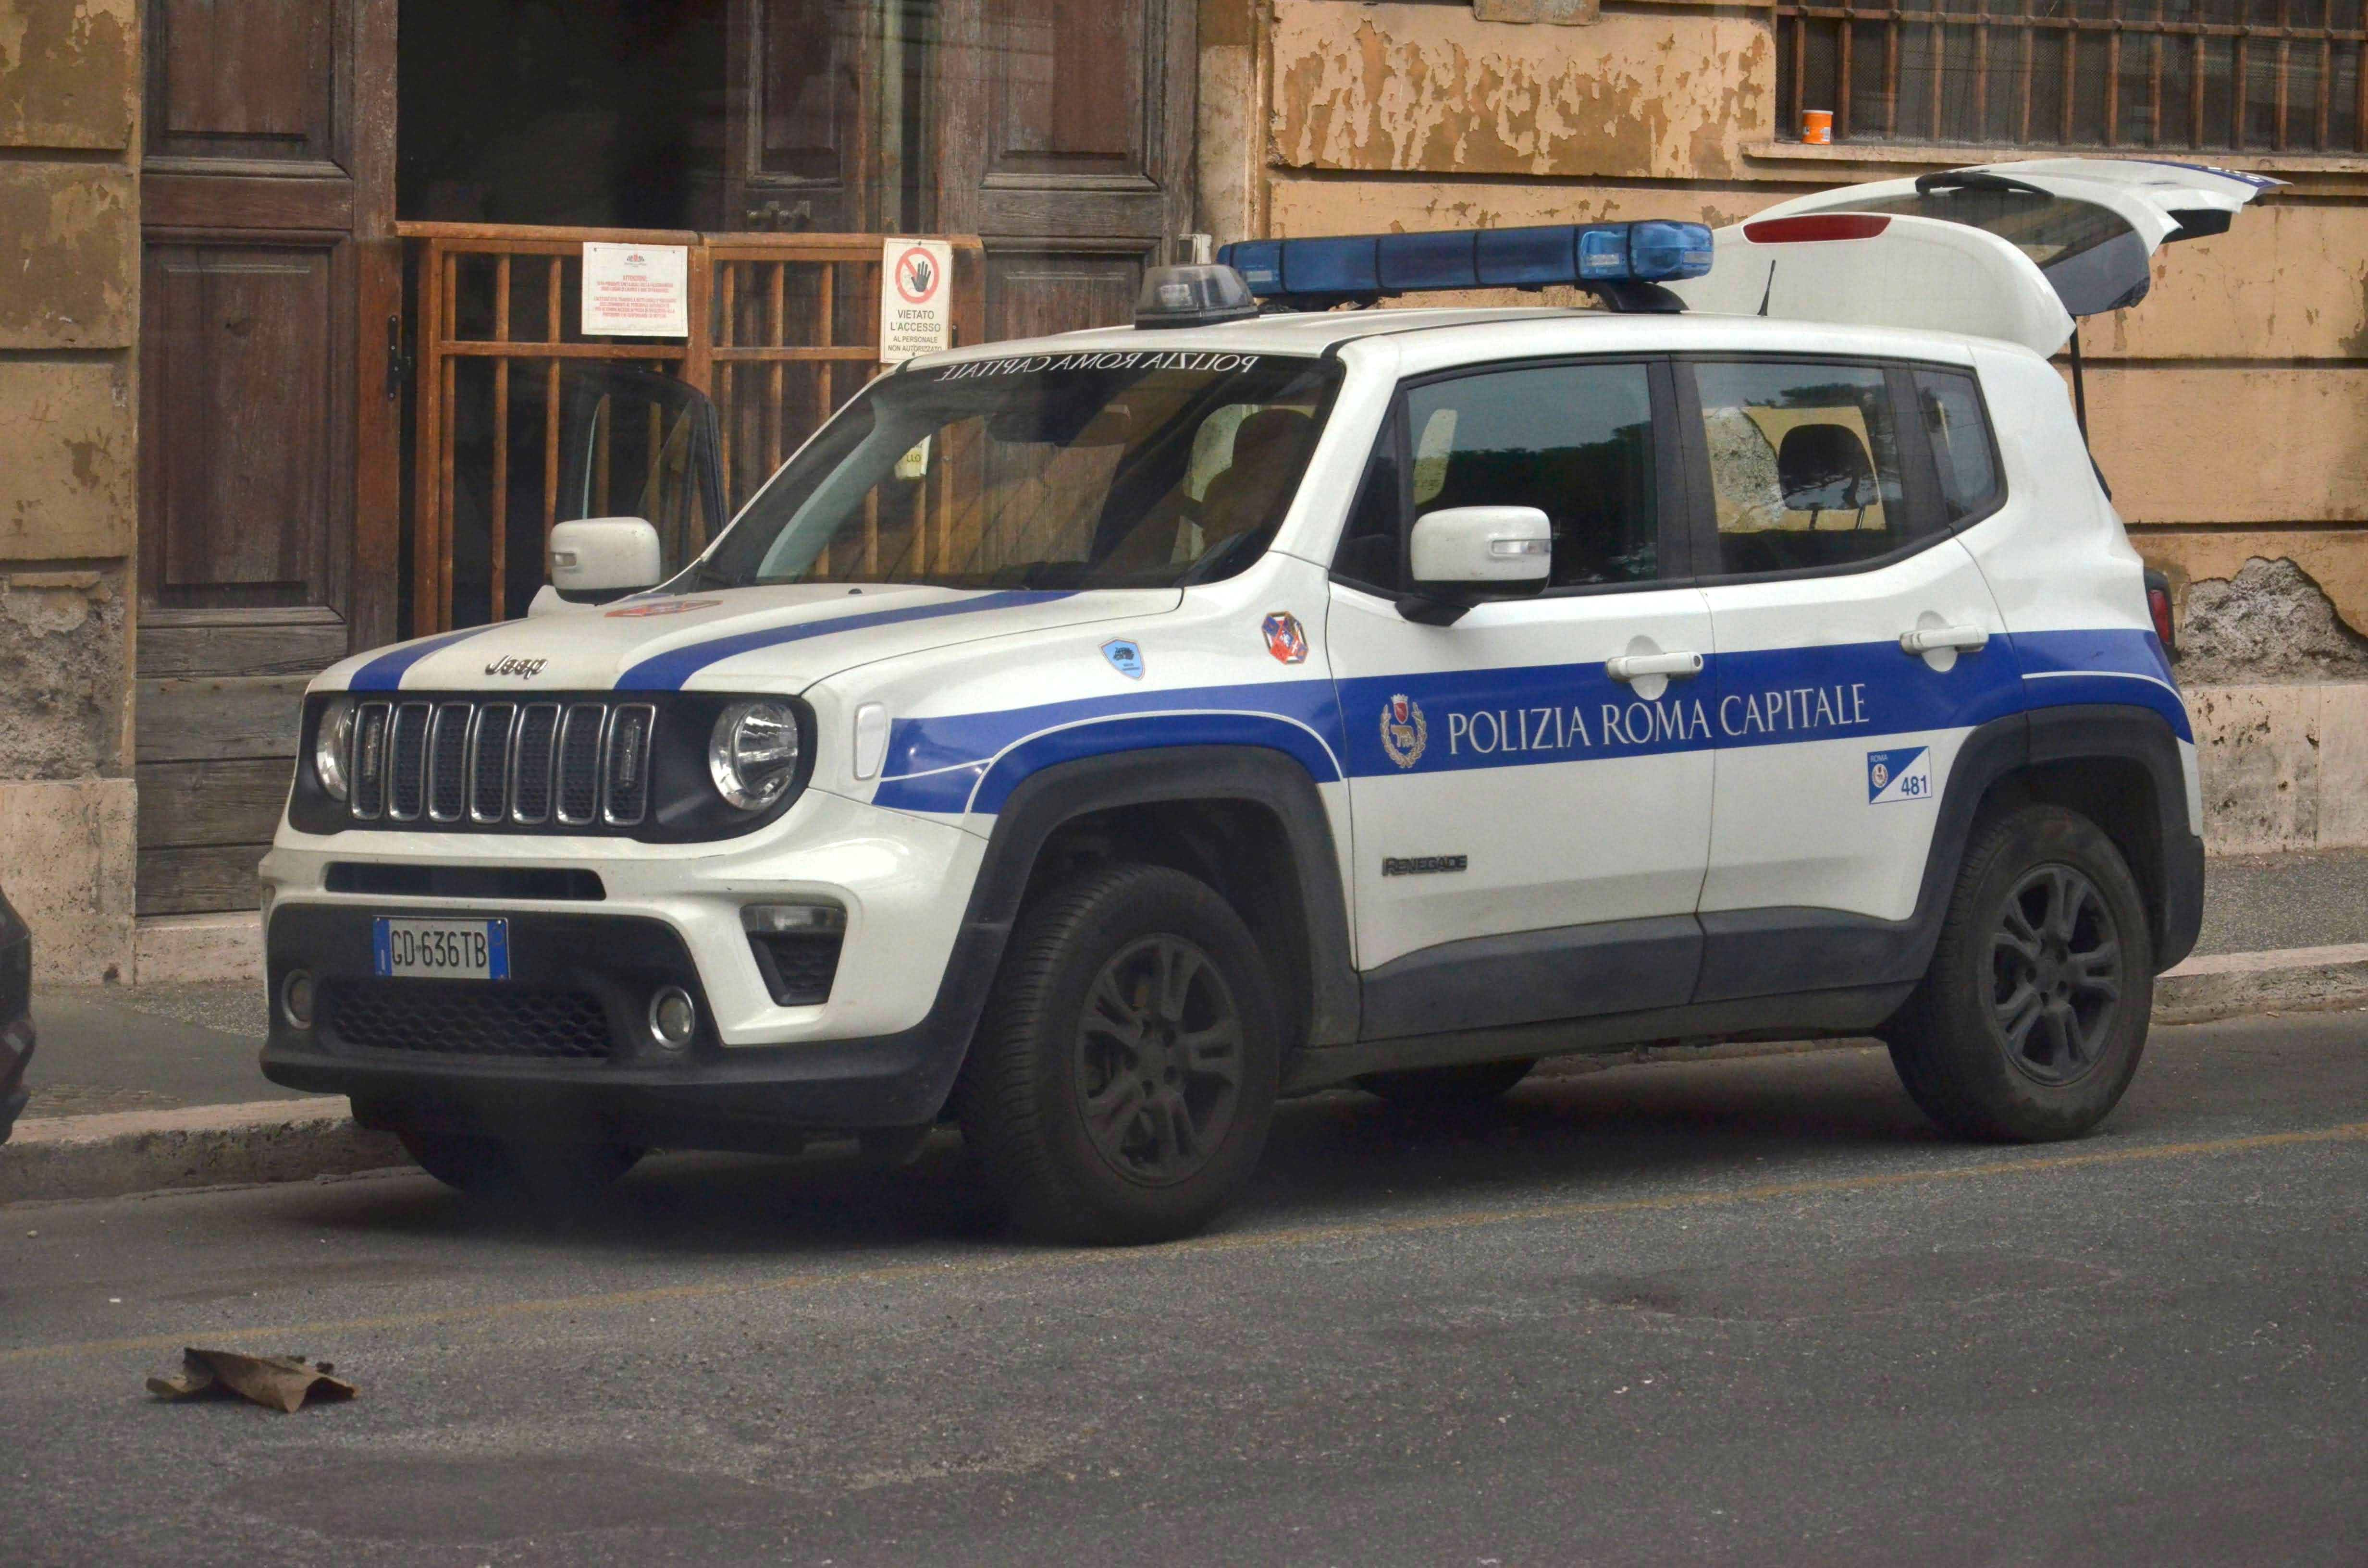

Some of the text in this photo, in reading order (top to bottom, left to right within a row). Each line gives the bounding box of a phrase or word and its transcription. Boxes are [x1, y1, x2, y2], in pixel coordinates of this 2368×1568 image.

[898, 310, 935, 319] VIETATO
[890, 322, 941, 332] L'ACCESSO
[485, 654, 548, 680] Jeep
[1447, 683, 1870, 754] POLIZIA ROMA CAPITALE
[1870, 754, 1888, 762] ROMA
[1901, 775, 1927, 796] 481
